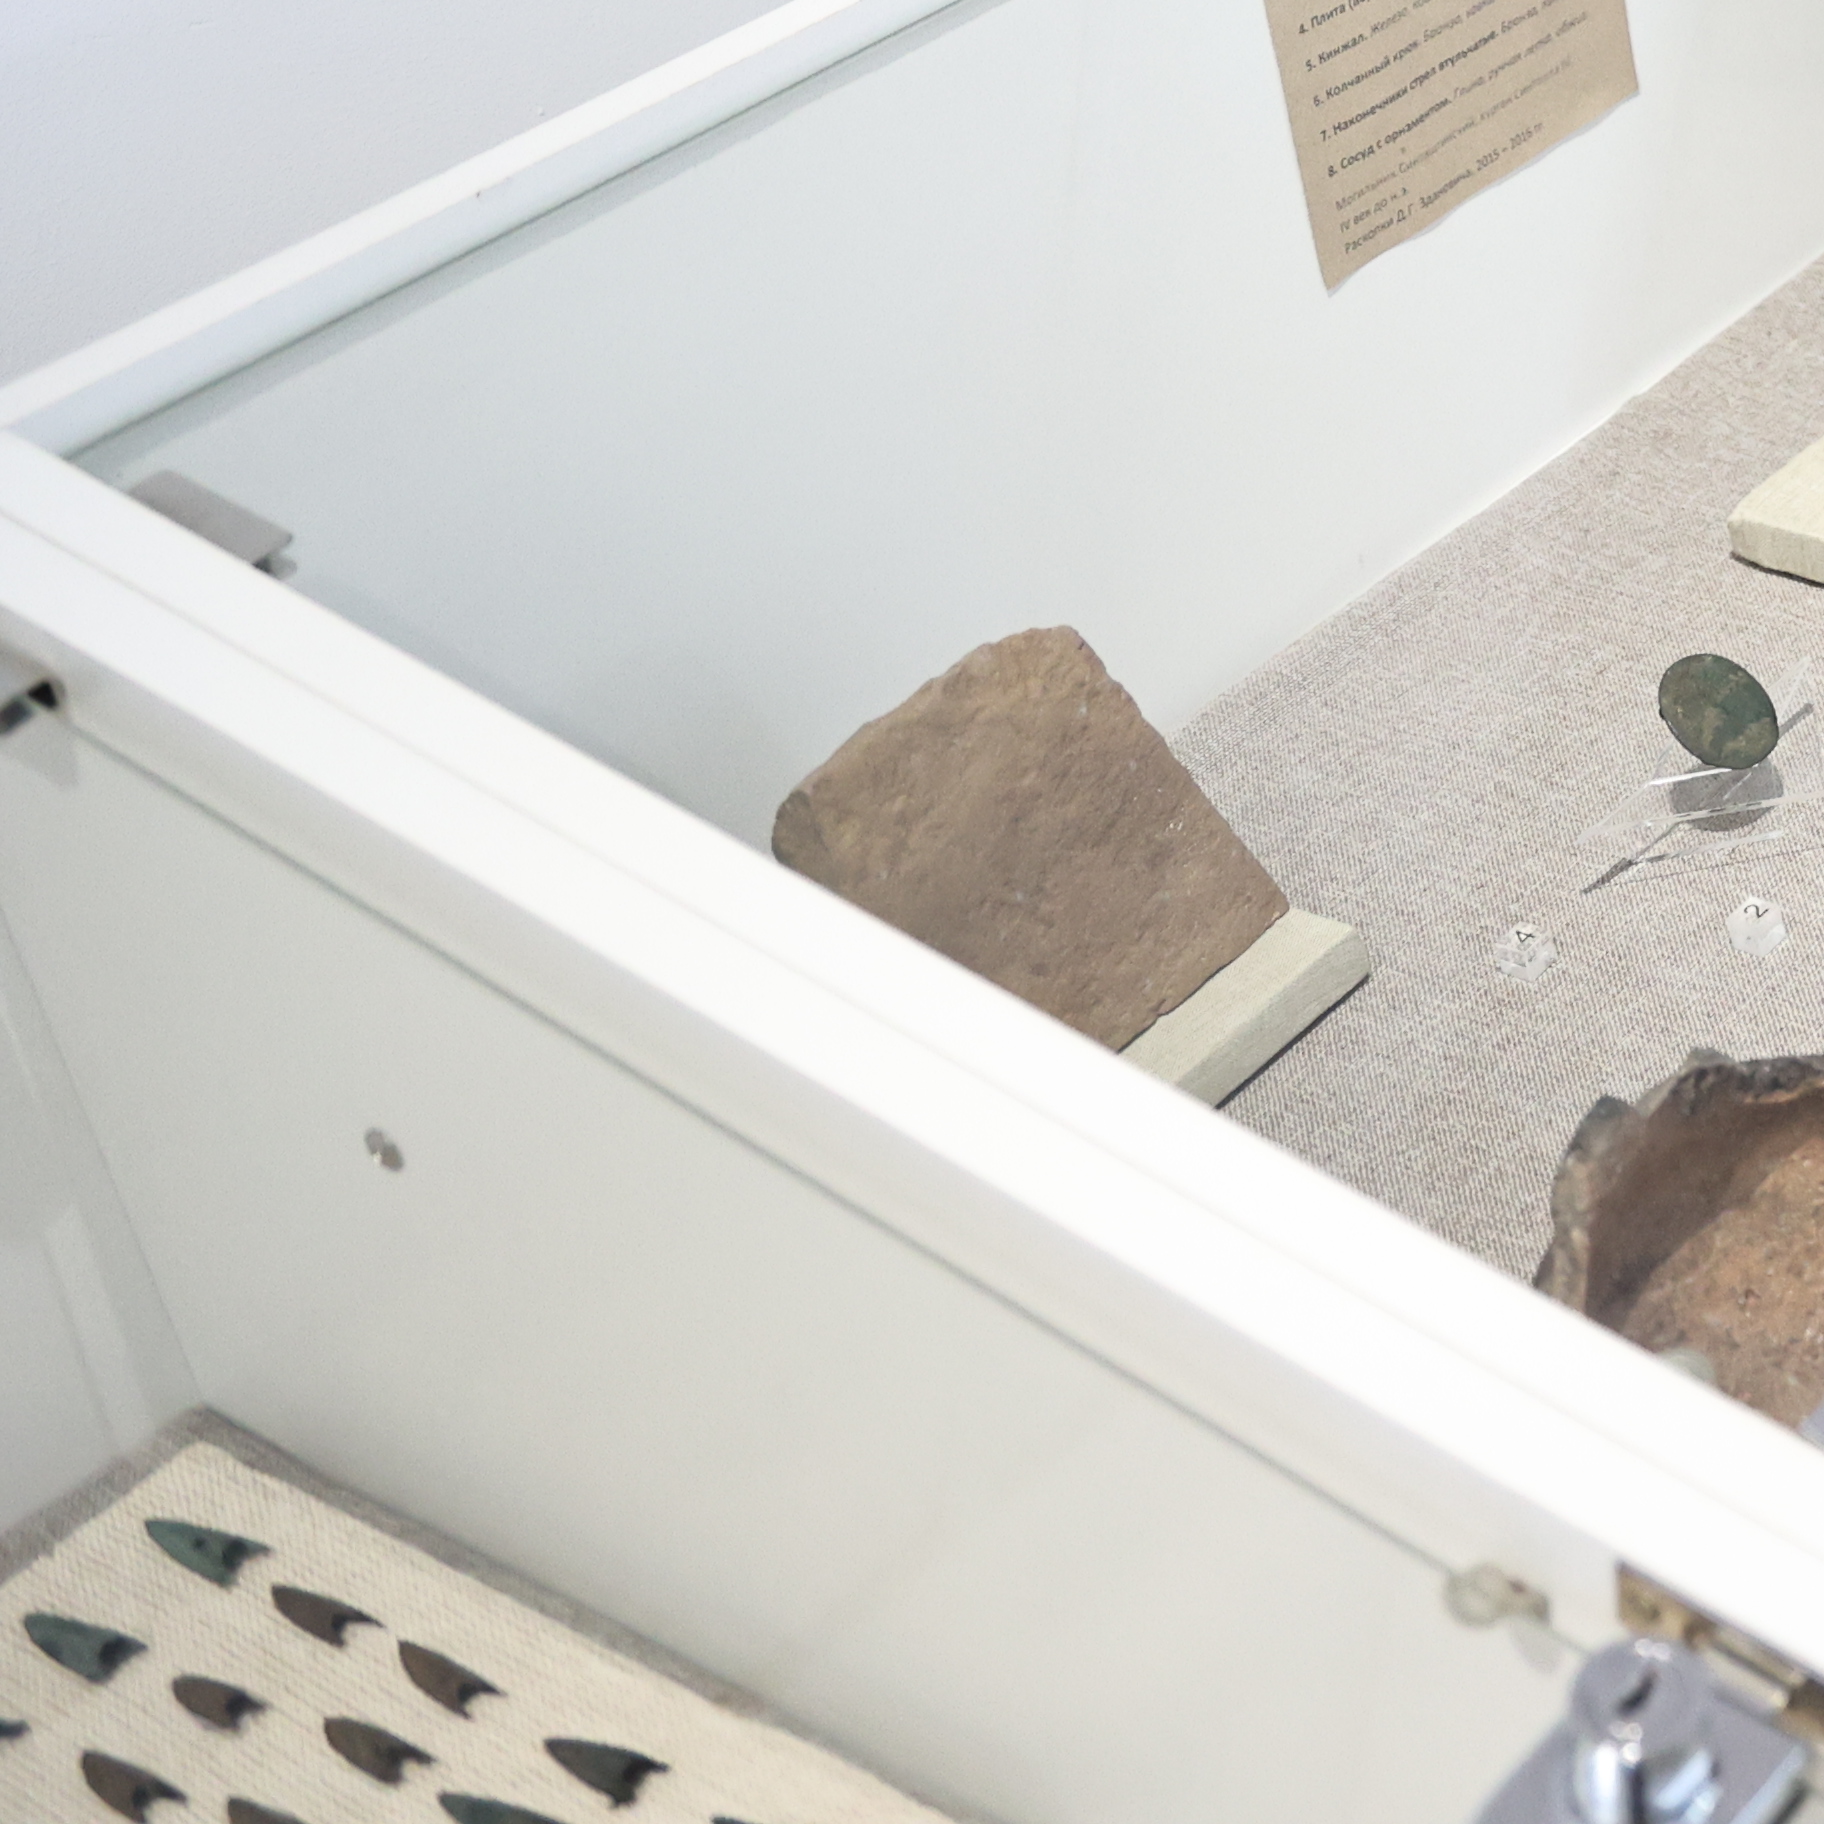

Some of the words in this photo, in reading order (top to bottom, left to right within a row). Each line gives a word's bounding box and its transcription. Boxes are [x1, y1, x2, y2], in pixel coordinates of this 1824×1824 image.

[1310, 3, 1346, 29] Плита
[1318, 31, 1368, 65] Кинжал.
[1332, 84, 1408, 136] Наконечники
[1340, 143, 1376, 170] Сосуд
[1743, 903, 1769, 919] 2
[1515, 930, 1536, 943] 4
